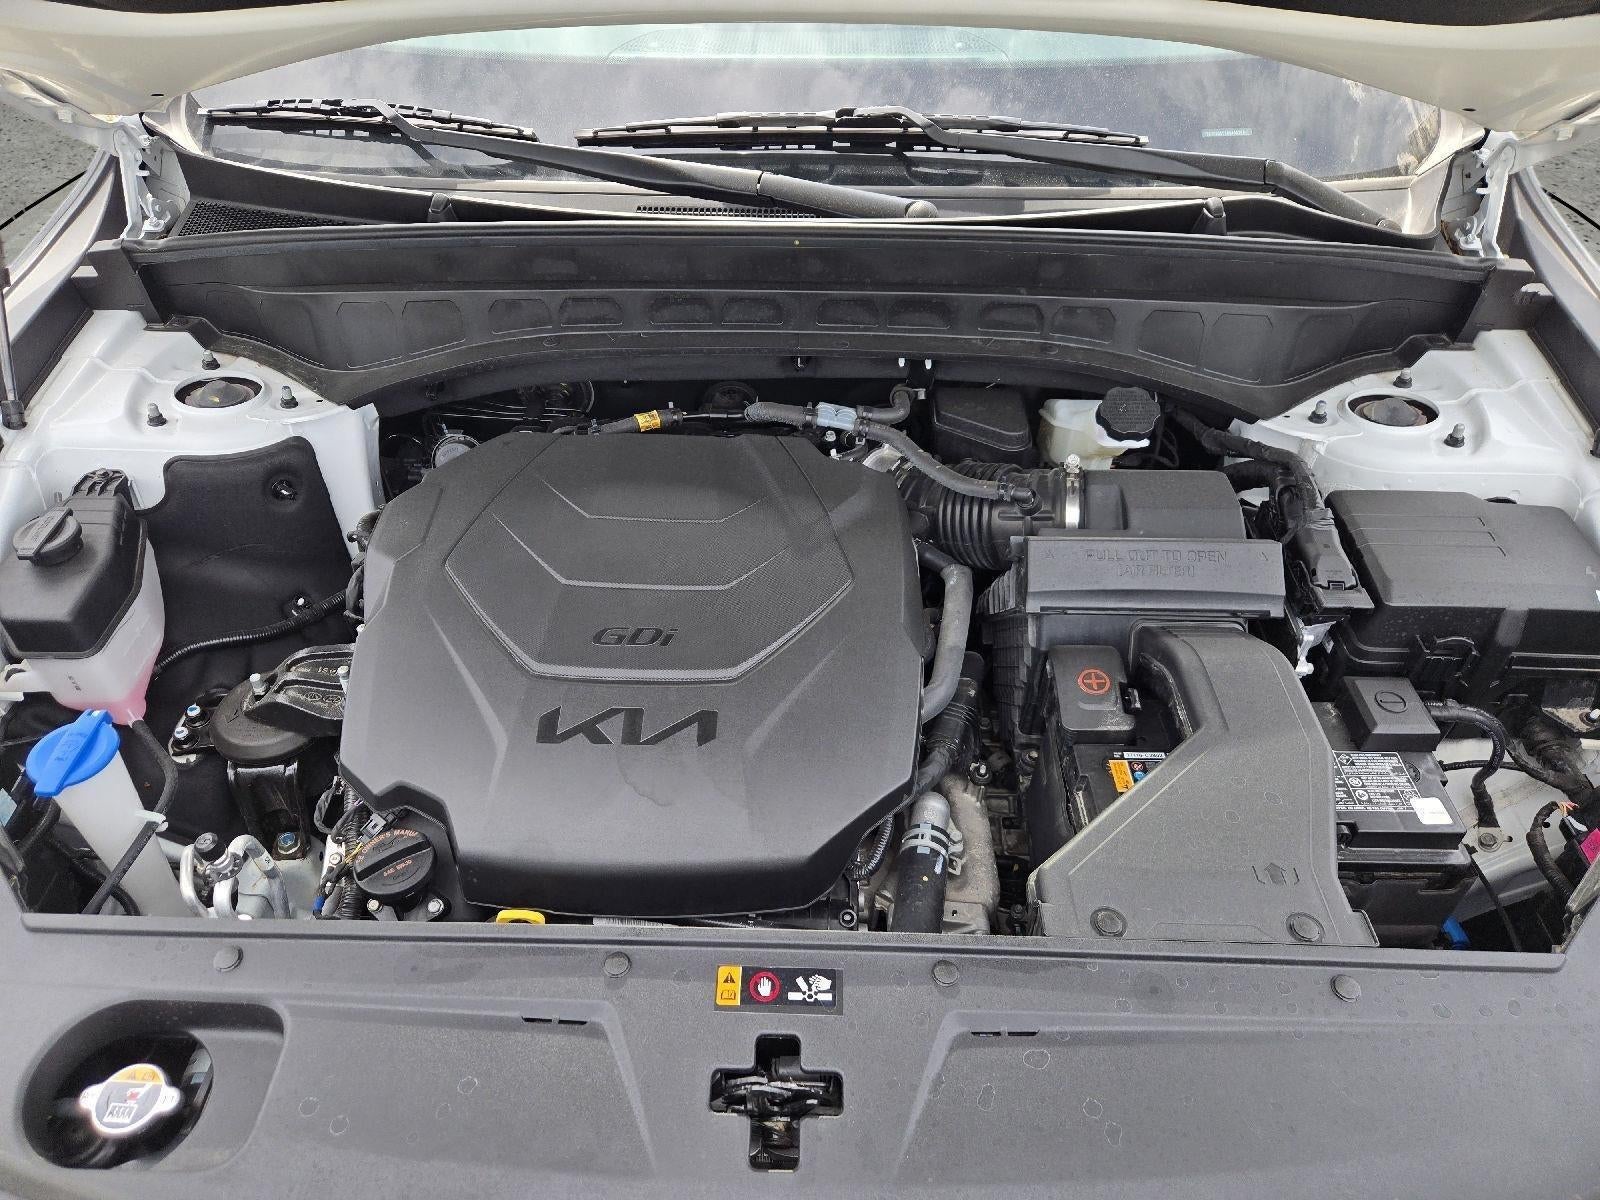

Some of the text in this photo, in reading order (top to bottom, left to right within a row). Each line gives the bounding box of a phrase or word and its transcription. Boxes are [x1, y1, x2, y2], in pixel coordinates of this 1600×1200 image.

[1086, 549, 1227, 563] PULL OUT TO OPEN
[592, 627, 679, 647] GDi
[536, 705, 719, 748] KIA
[362, 832, 391, 853] OWNER'S
